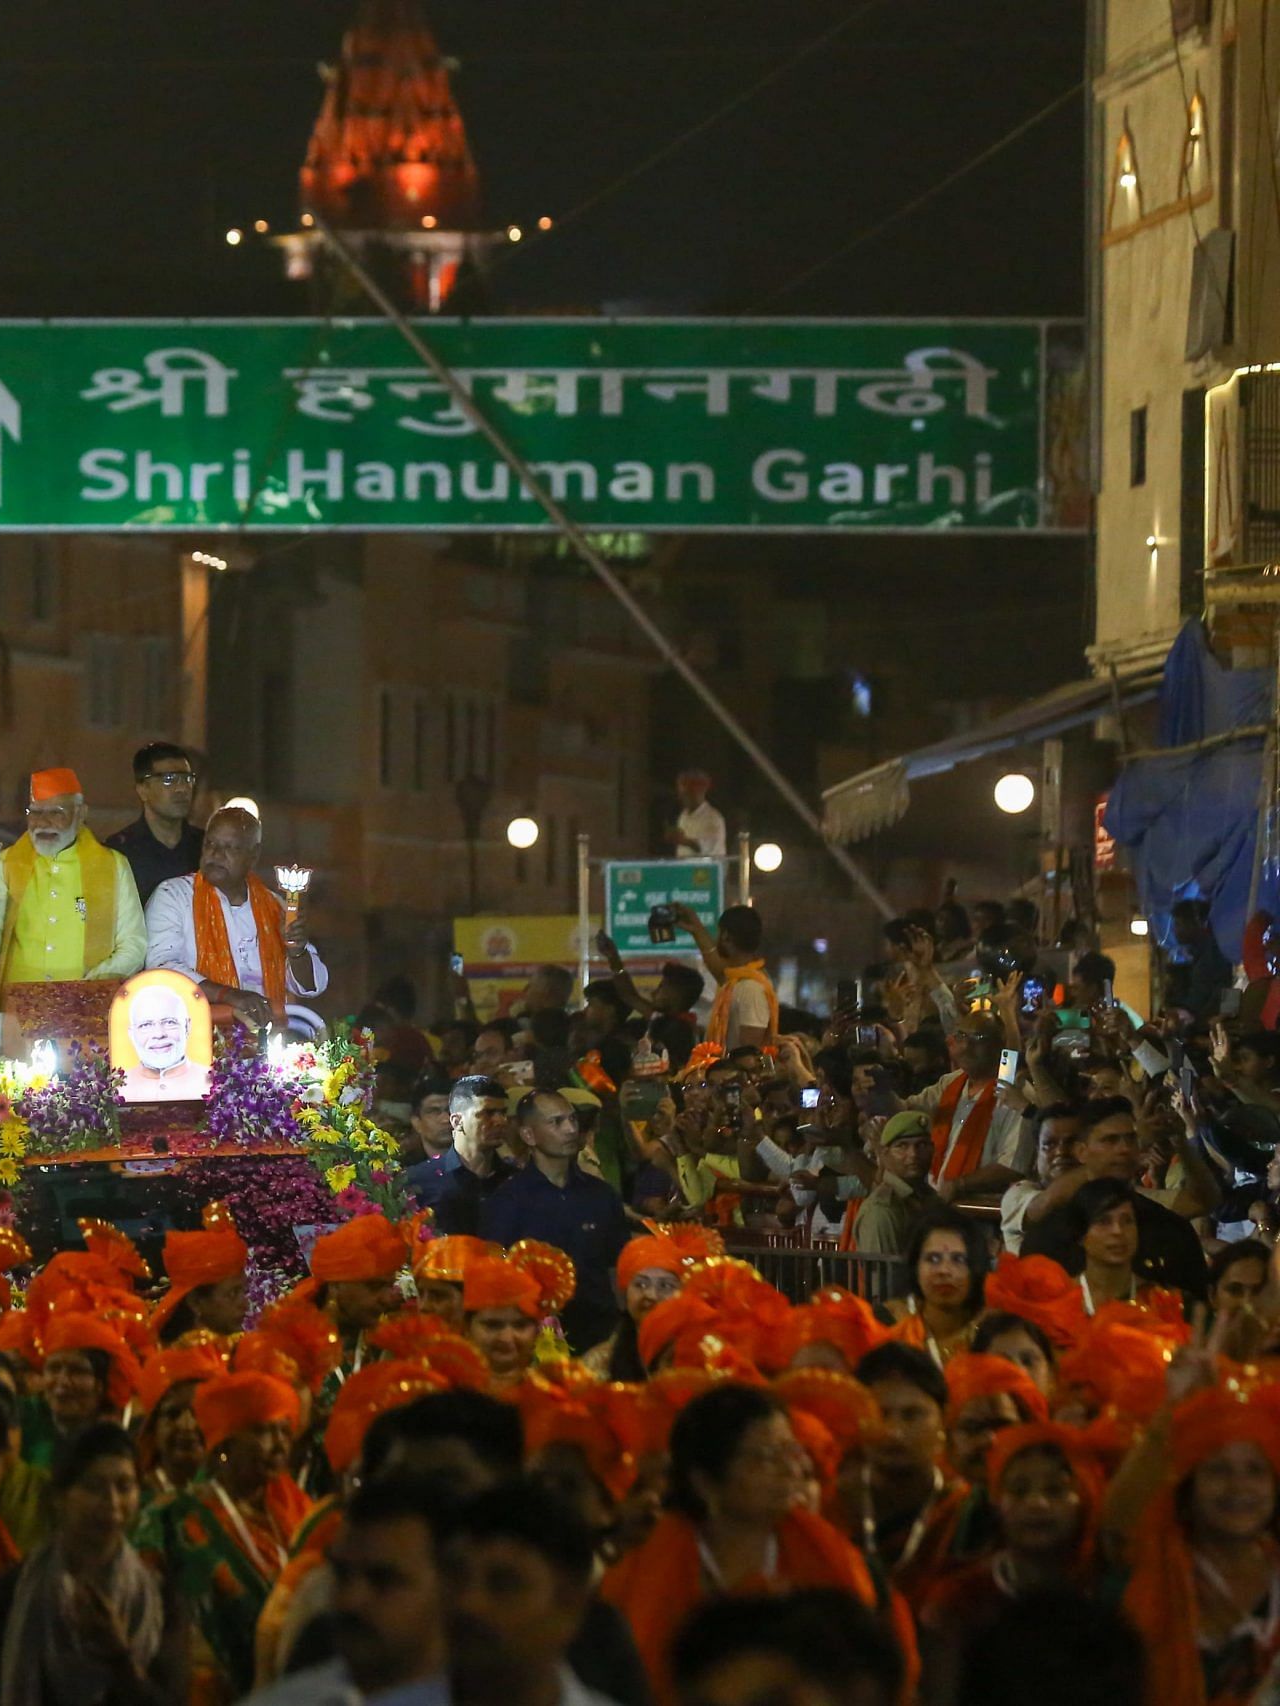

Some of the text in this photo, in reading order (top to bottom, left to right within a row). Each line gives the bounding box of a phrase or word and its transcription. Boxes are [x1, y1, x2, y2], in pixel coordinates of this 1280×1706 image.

[80, 347, 239, 417] श्री
[79, 448, 992, 502] Shri Hanuman Garhi
